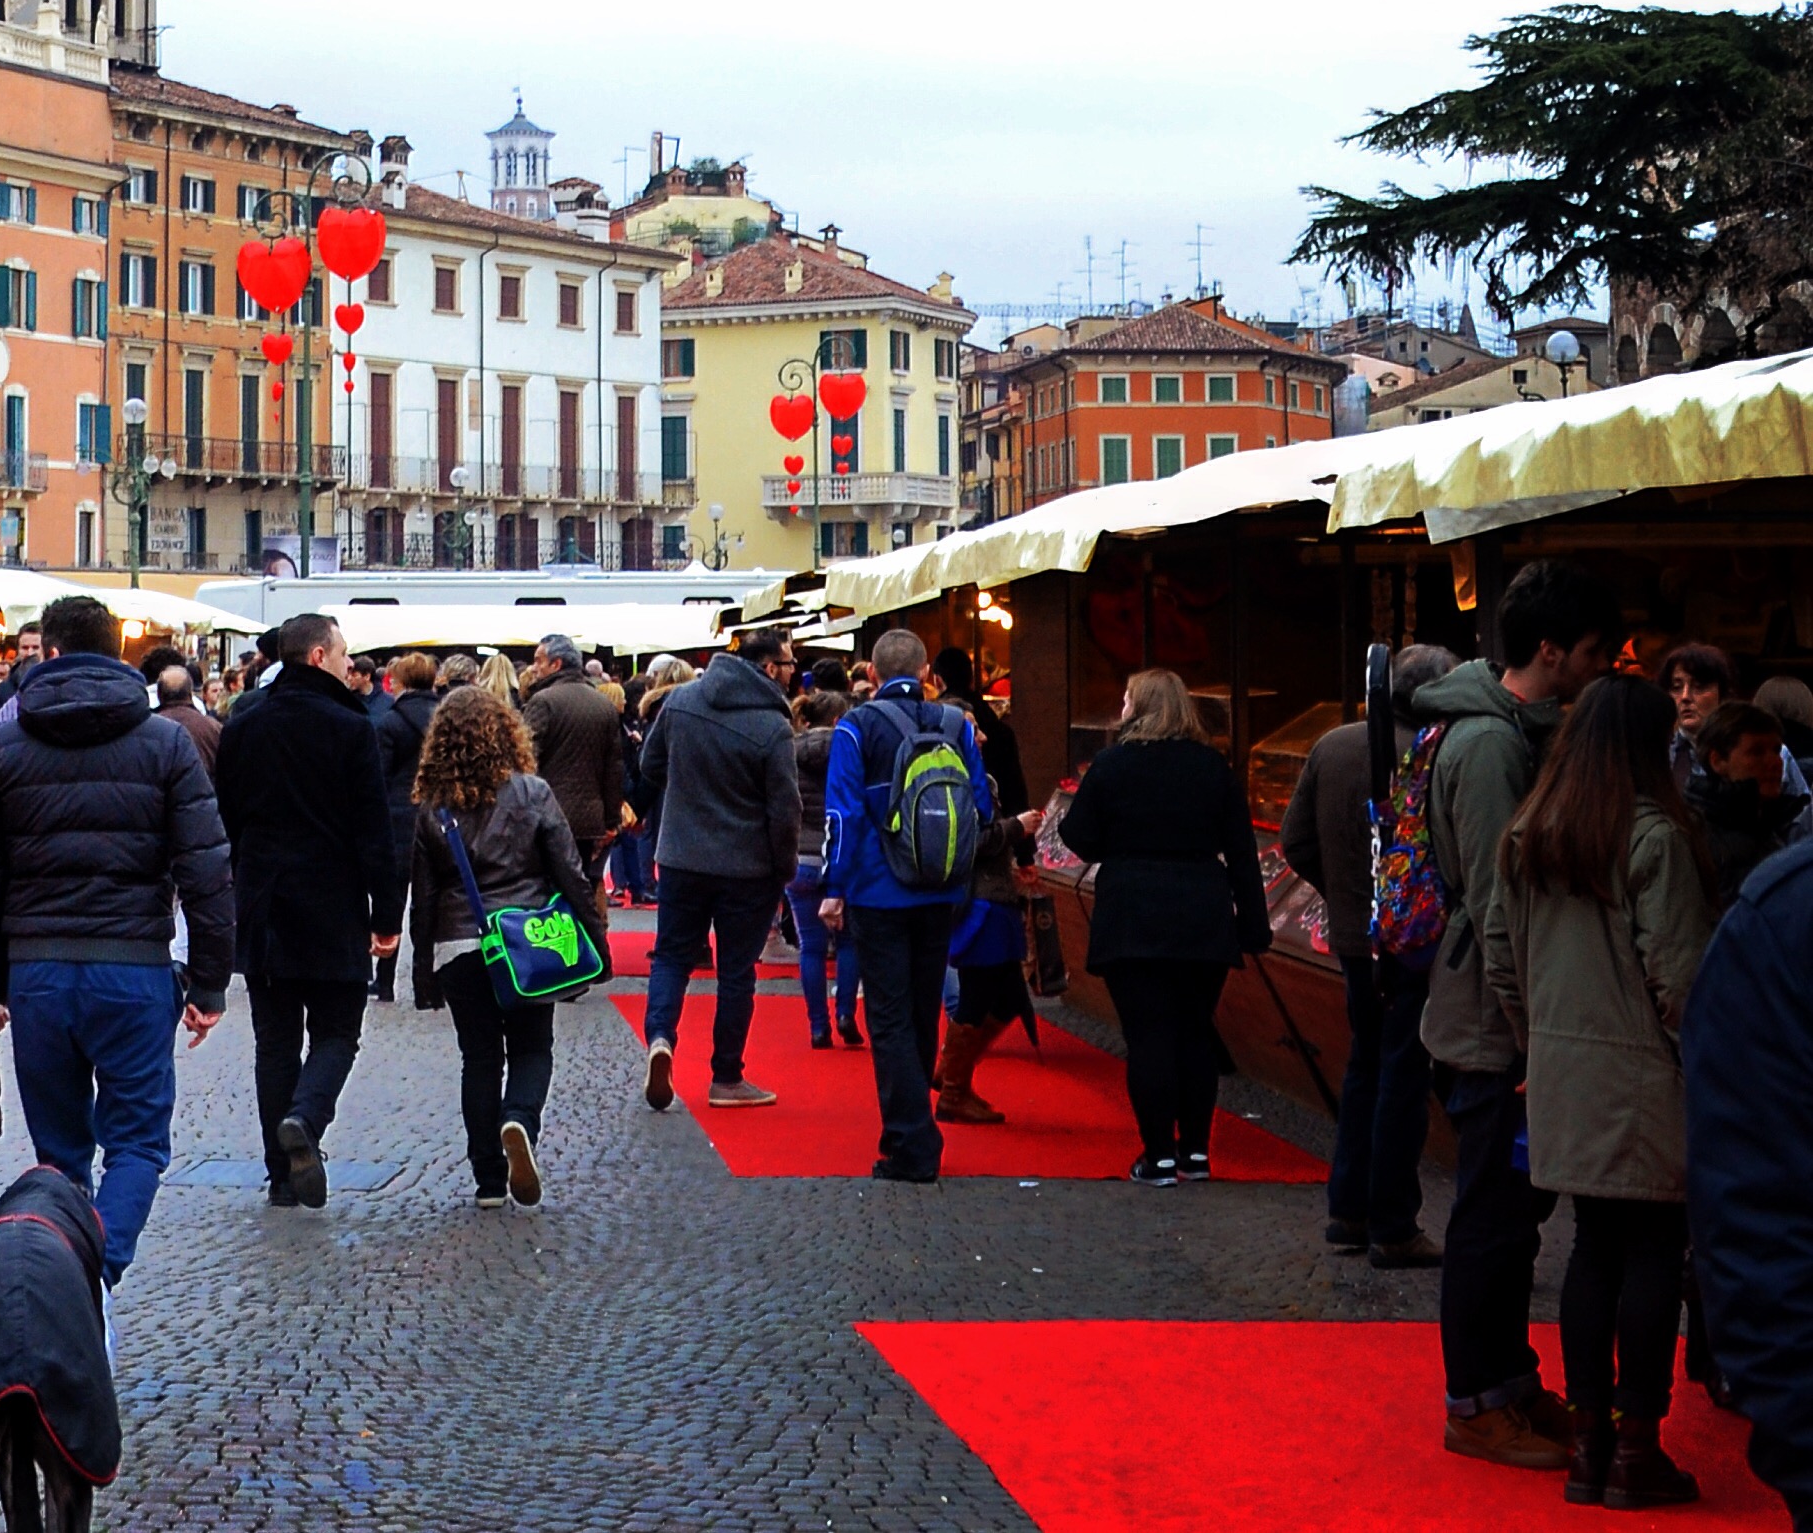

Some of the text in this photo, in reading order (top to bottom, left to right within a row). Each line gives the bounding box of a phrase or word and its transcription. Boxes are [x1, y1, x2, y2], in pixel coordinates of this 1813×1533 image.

[150, 507, 186, 522] BANCA
[264, 510, 297, 525] BANCA
[151, 539, 185, 550] EXCHANGE
[524, 911, 575, 943] Gola
